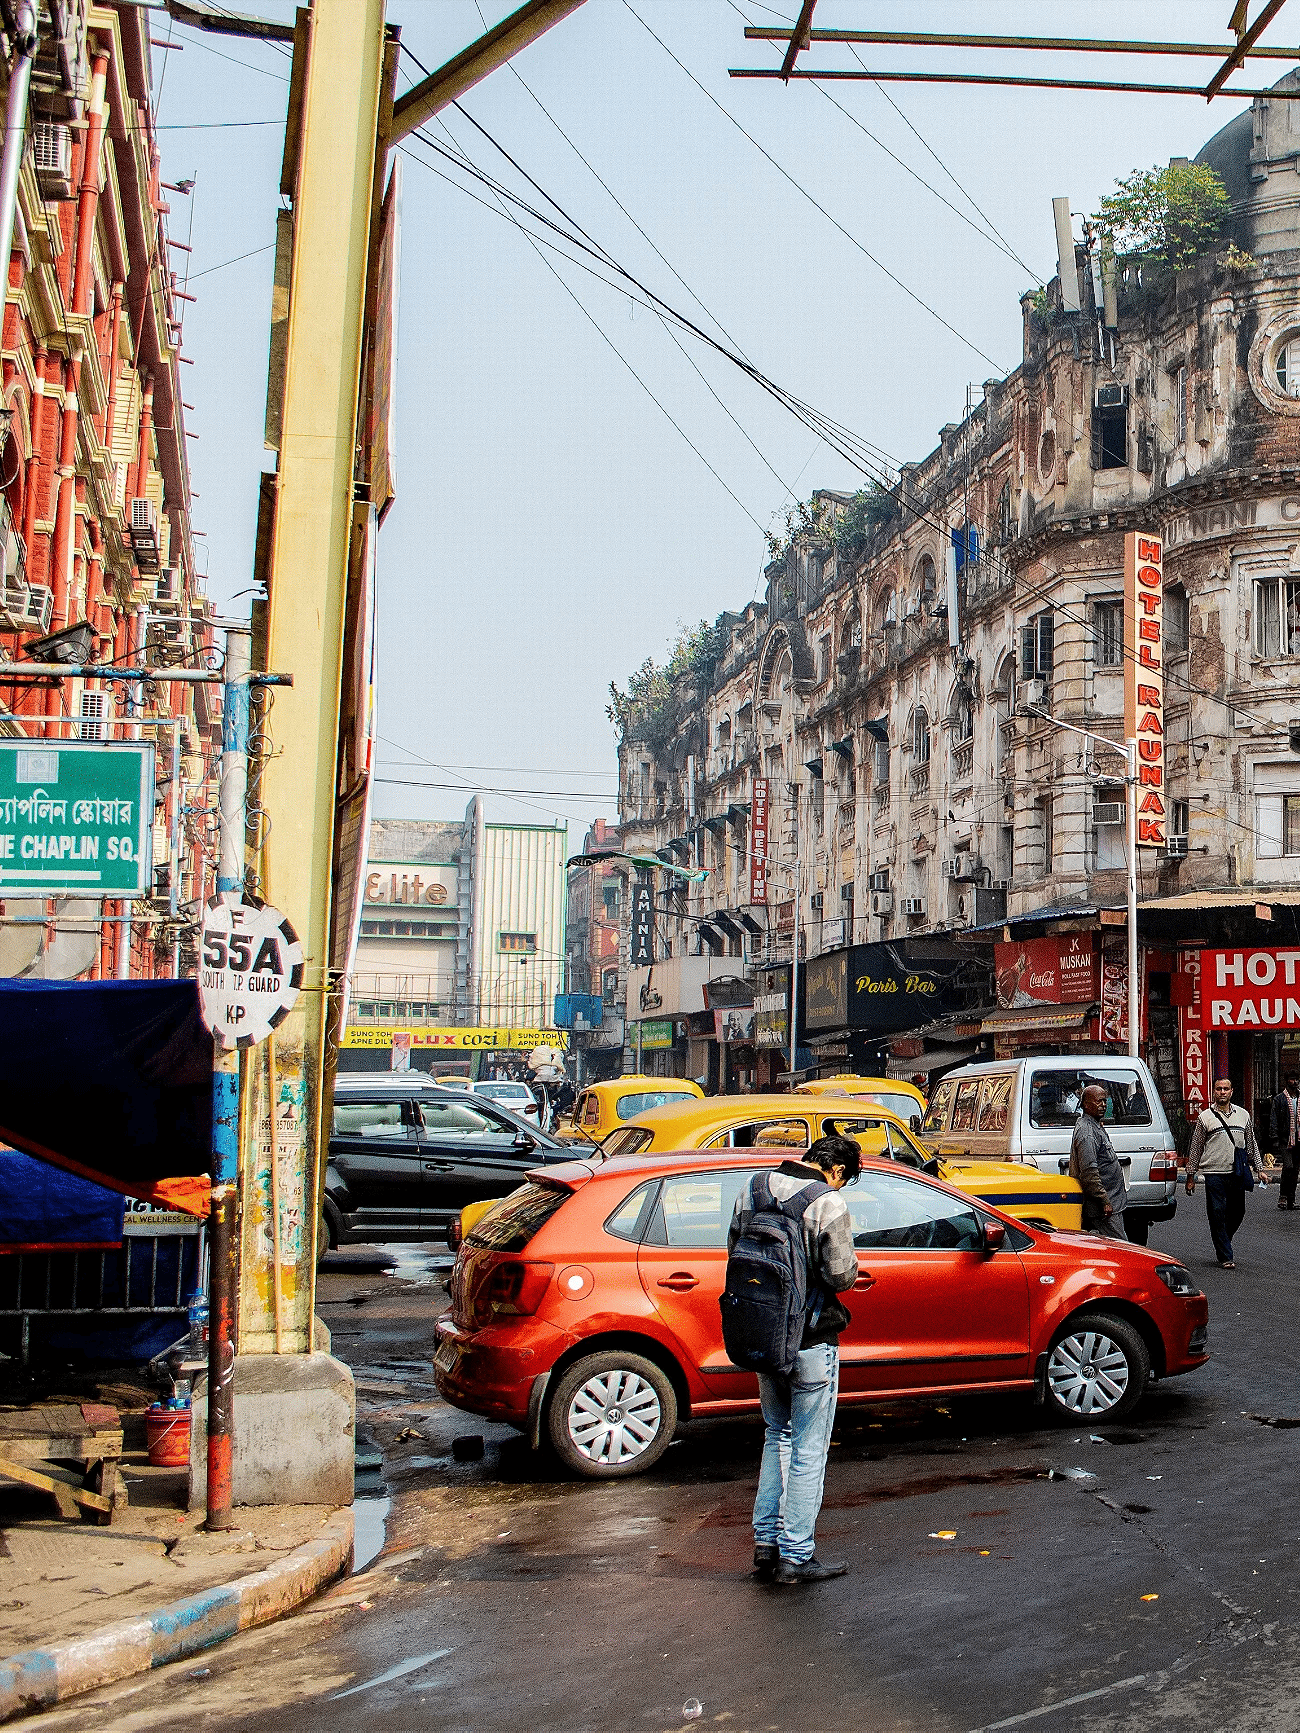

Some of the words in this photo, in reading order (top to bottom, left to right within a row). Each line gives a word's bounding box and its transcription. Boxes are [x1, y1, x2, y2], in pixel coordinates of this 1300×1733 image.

[1137, 537, 1162, 670] HOTEL
[1137, 683, 1166, 843] RAUNAK
[755, 780, 766, 826] HOTEL
[21, 835, 100, 859] CHAPLIN
[106, 836, 139, 862] SQ.
[754, 829, 766, 866] BEST
[366, 872, 448, 905] Elite
[753, 870, 765, 898] INN
[638, 889, 650, 958] AMINIA
[203, 929, 284, 976] 55A
[1069, 938, 1080, 953] JK
[1060, 953, 1091, 970] MUSKAN
[202, 970, 225, 990] SOUTH
[248, 976, 281, 993] GUARD
[856, 975, 899, 993] Paris
[905, 975, 937, 994] Bar
[226, 1004, 246, 1025] KP
[413, 1034, 457, 1045] LUX
[462, 1031, 499, 1046] cozi
[1186, 1029, 1204, 1115] RAUNAK
[139, 1215, 182, 1223] WELLNESS
